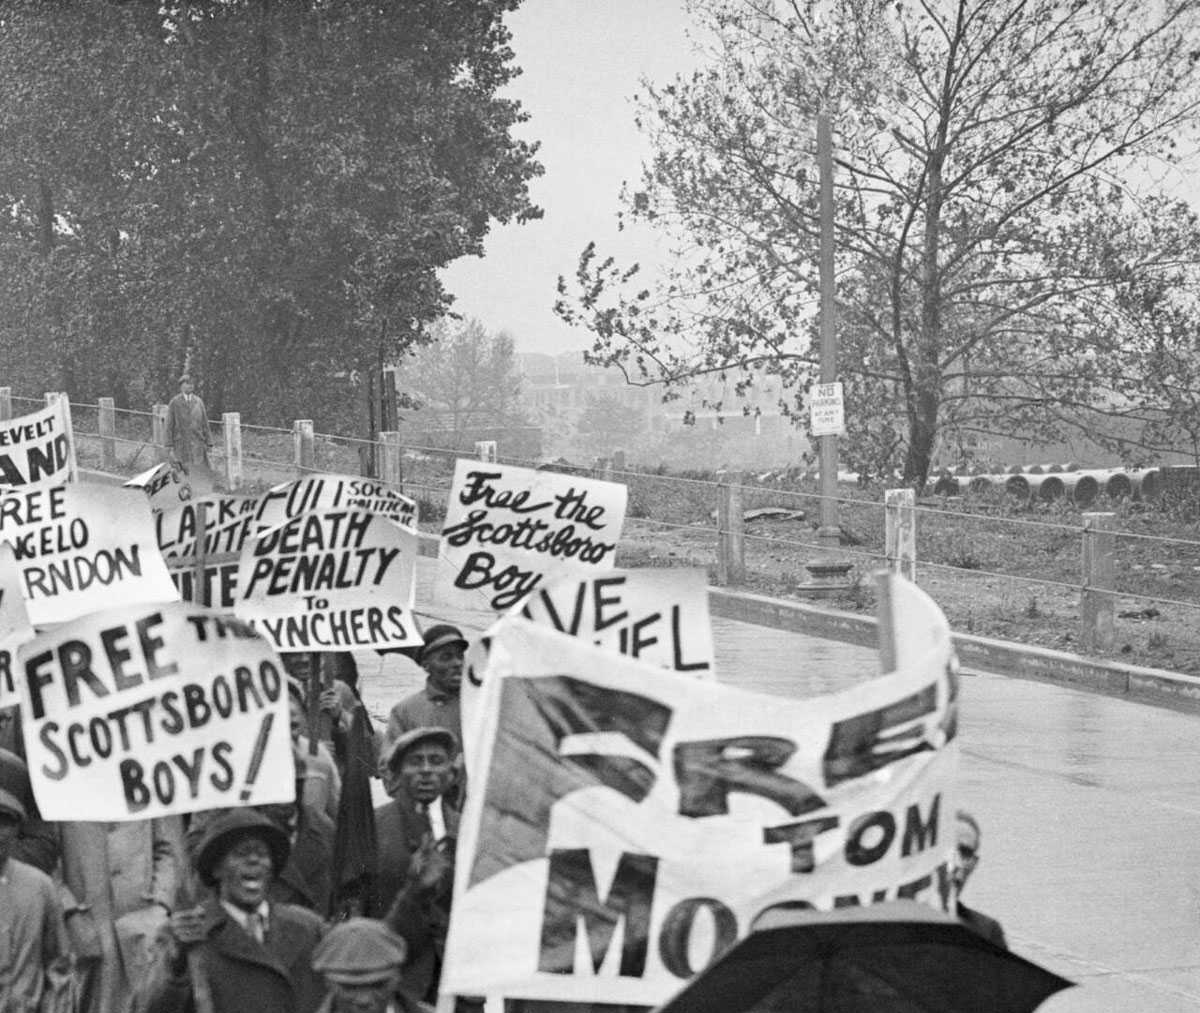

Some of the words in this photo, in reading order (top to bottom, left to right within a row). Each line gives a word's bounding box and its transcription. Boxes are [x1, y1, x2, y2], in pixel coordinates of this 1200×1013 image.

[459, 471, 554, 514] Free
[555, 488, 607, 530] the
[253, 511, 374, 557] DEATH
[441, 509, 616, 564] Scottsboro
[22, 543, 142, 600] RNDON
[242, 547, 401, 600] PENALTY
[453, 551, 543, 610] Boy
[258, 605, 408, 648] YNCHERS
[24, 612, 180, 720] FREE
[39, 659, 281, 781] SCOTTSBORO
[119, 711, 275, 815] BOYS!
[763, 793, 942, 874] TOM
